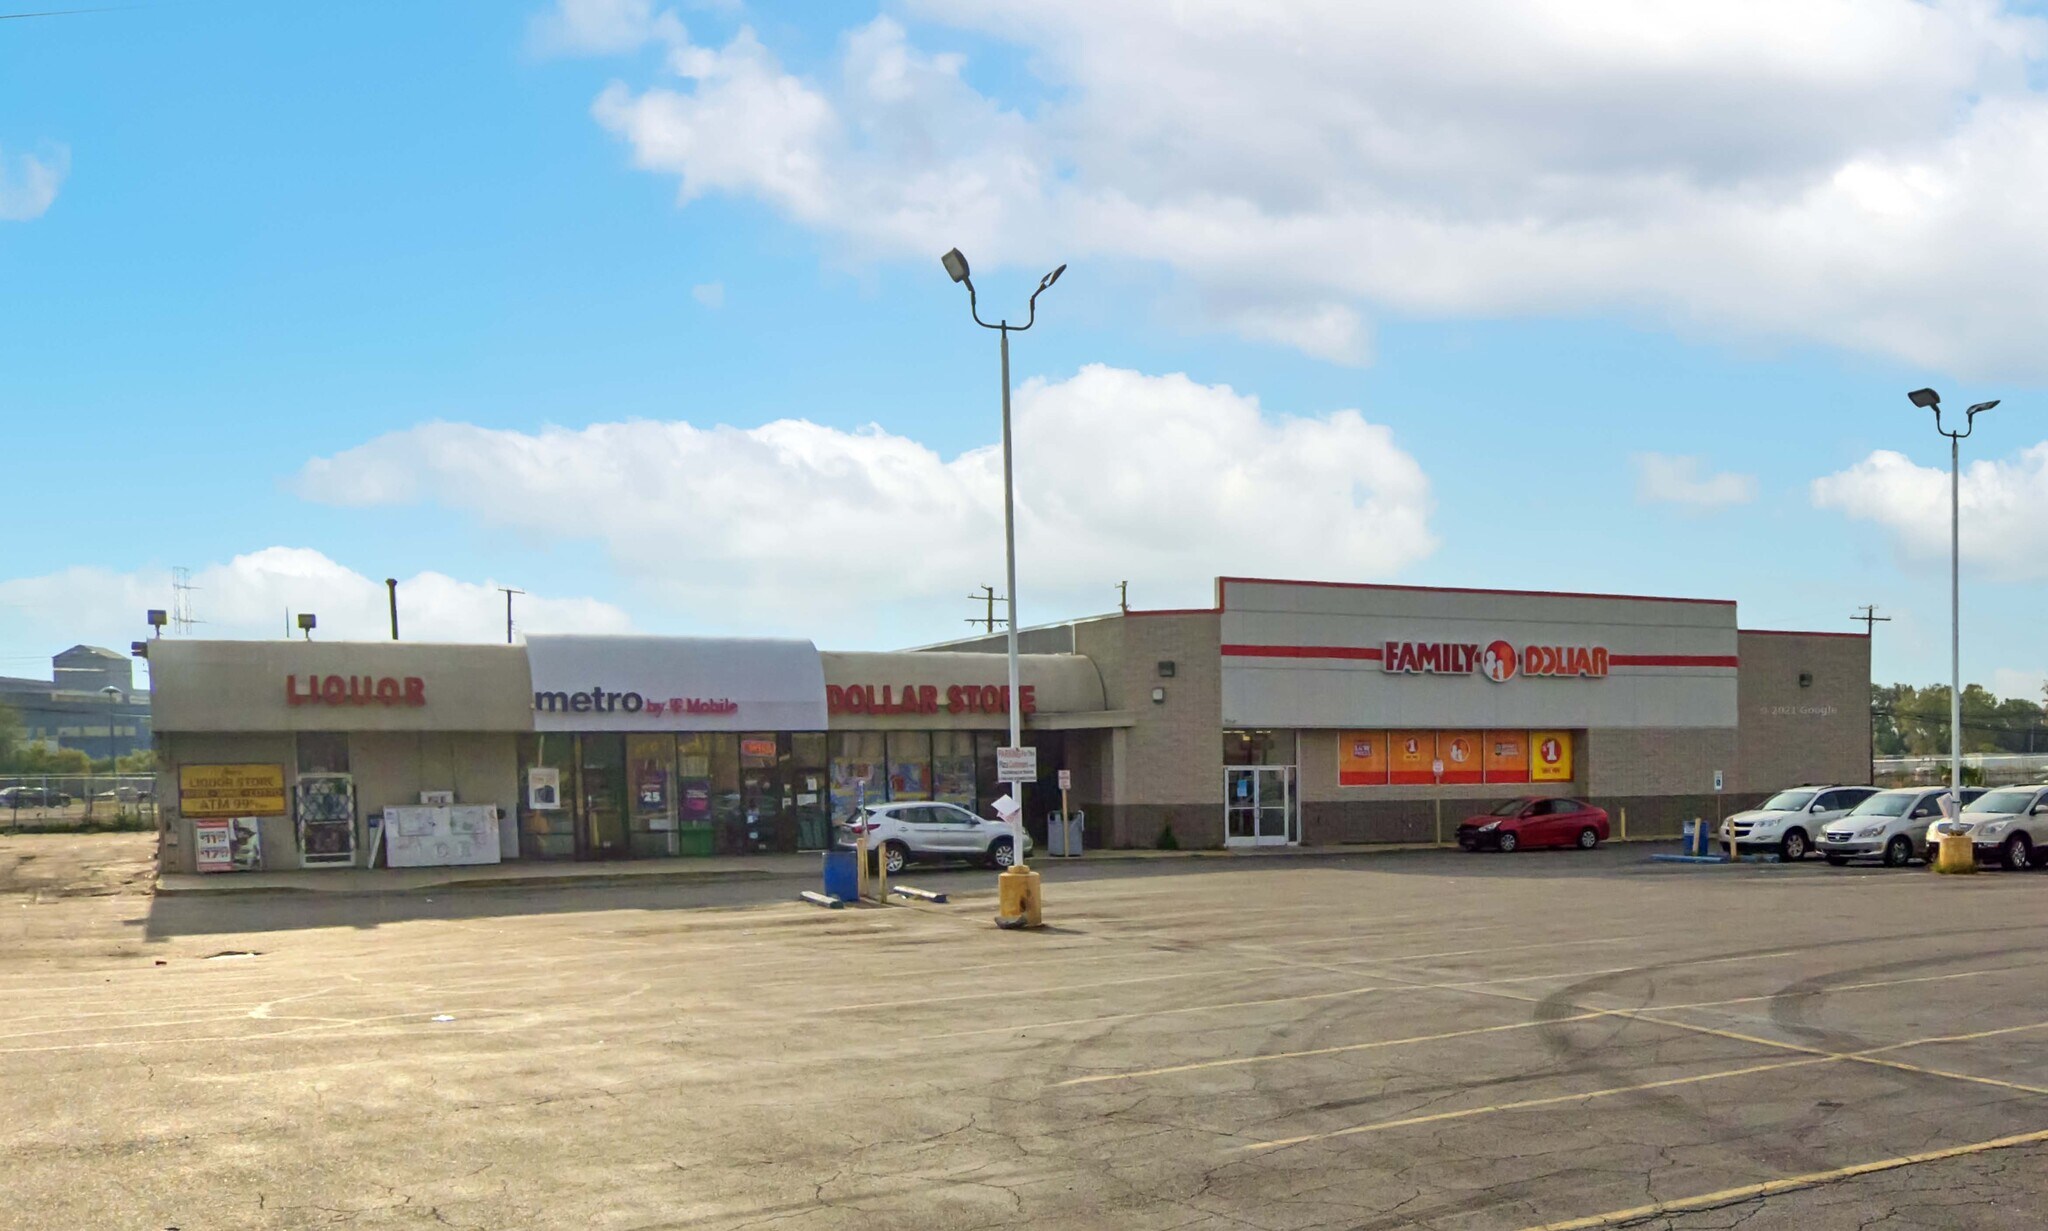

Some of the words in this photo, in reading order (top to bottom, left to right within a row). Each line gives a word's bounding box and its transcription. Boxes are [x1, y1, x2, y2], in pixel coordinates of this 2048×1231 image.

[1385, 641, 1479, 673] FAMILY
[1525, 645, 1609, 675] DOLLAR
[286, 675, 426, 706] LIQUOR
[535, 686, 643, 713] metro
[646, 698, 665, 718] by
[826, 684, 938, 714] DOLLAR
